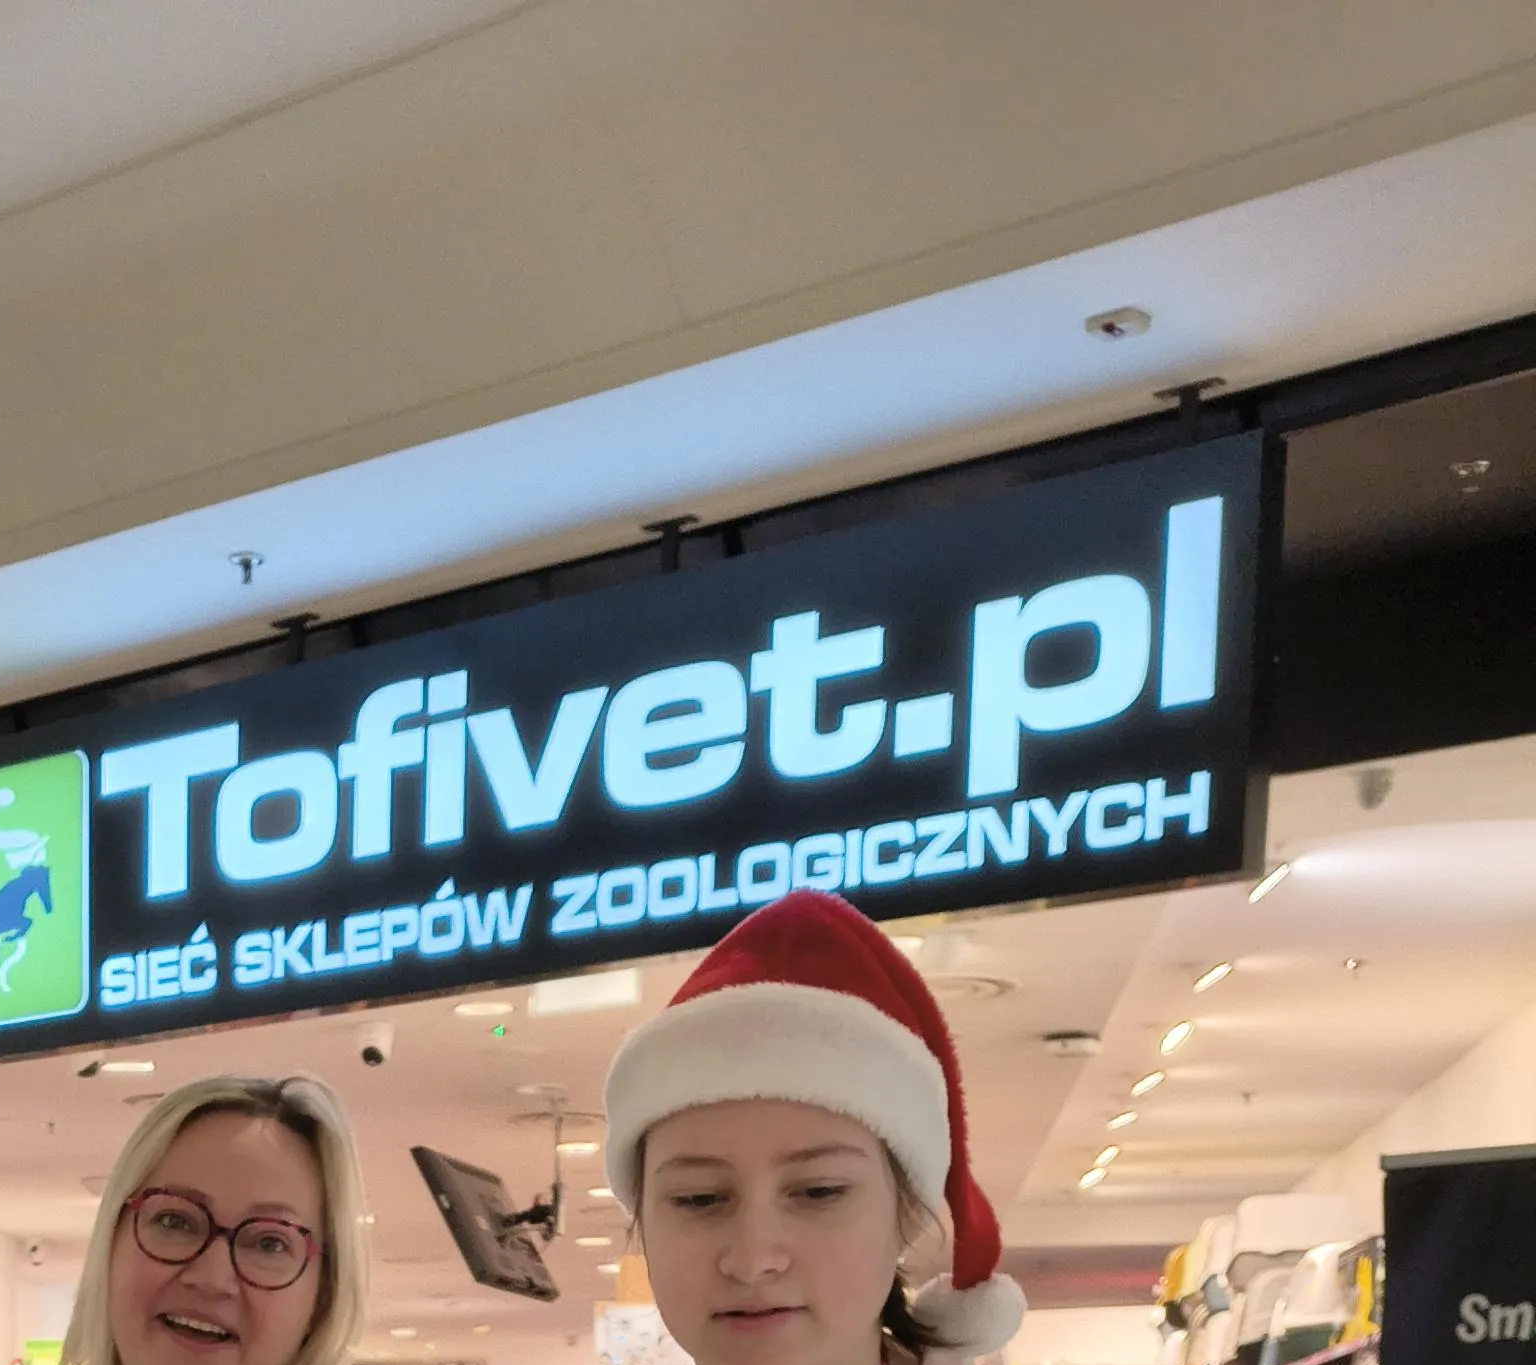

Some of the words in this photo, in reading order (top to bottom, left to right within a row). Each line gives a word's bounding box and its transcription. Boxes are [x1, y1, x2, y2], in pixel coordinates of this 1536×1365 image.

[100, 496, 1218, 898] Tofivet.pl
[99, 921, 218, 1008] SIEĆ
[232, 882, 539, 987] SKLEPÓW
[551, 771, 1211, 935] ZOOLOGICZNYCH
[1455, 1292, 1536, 1345] Sm
